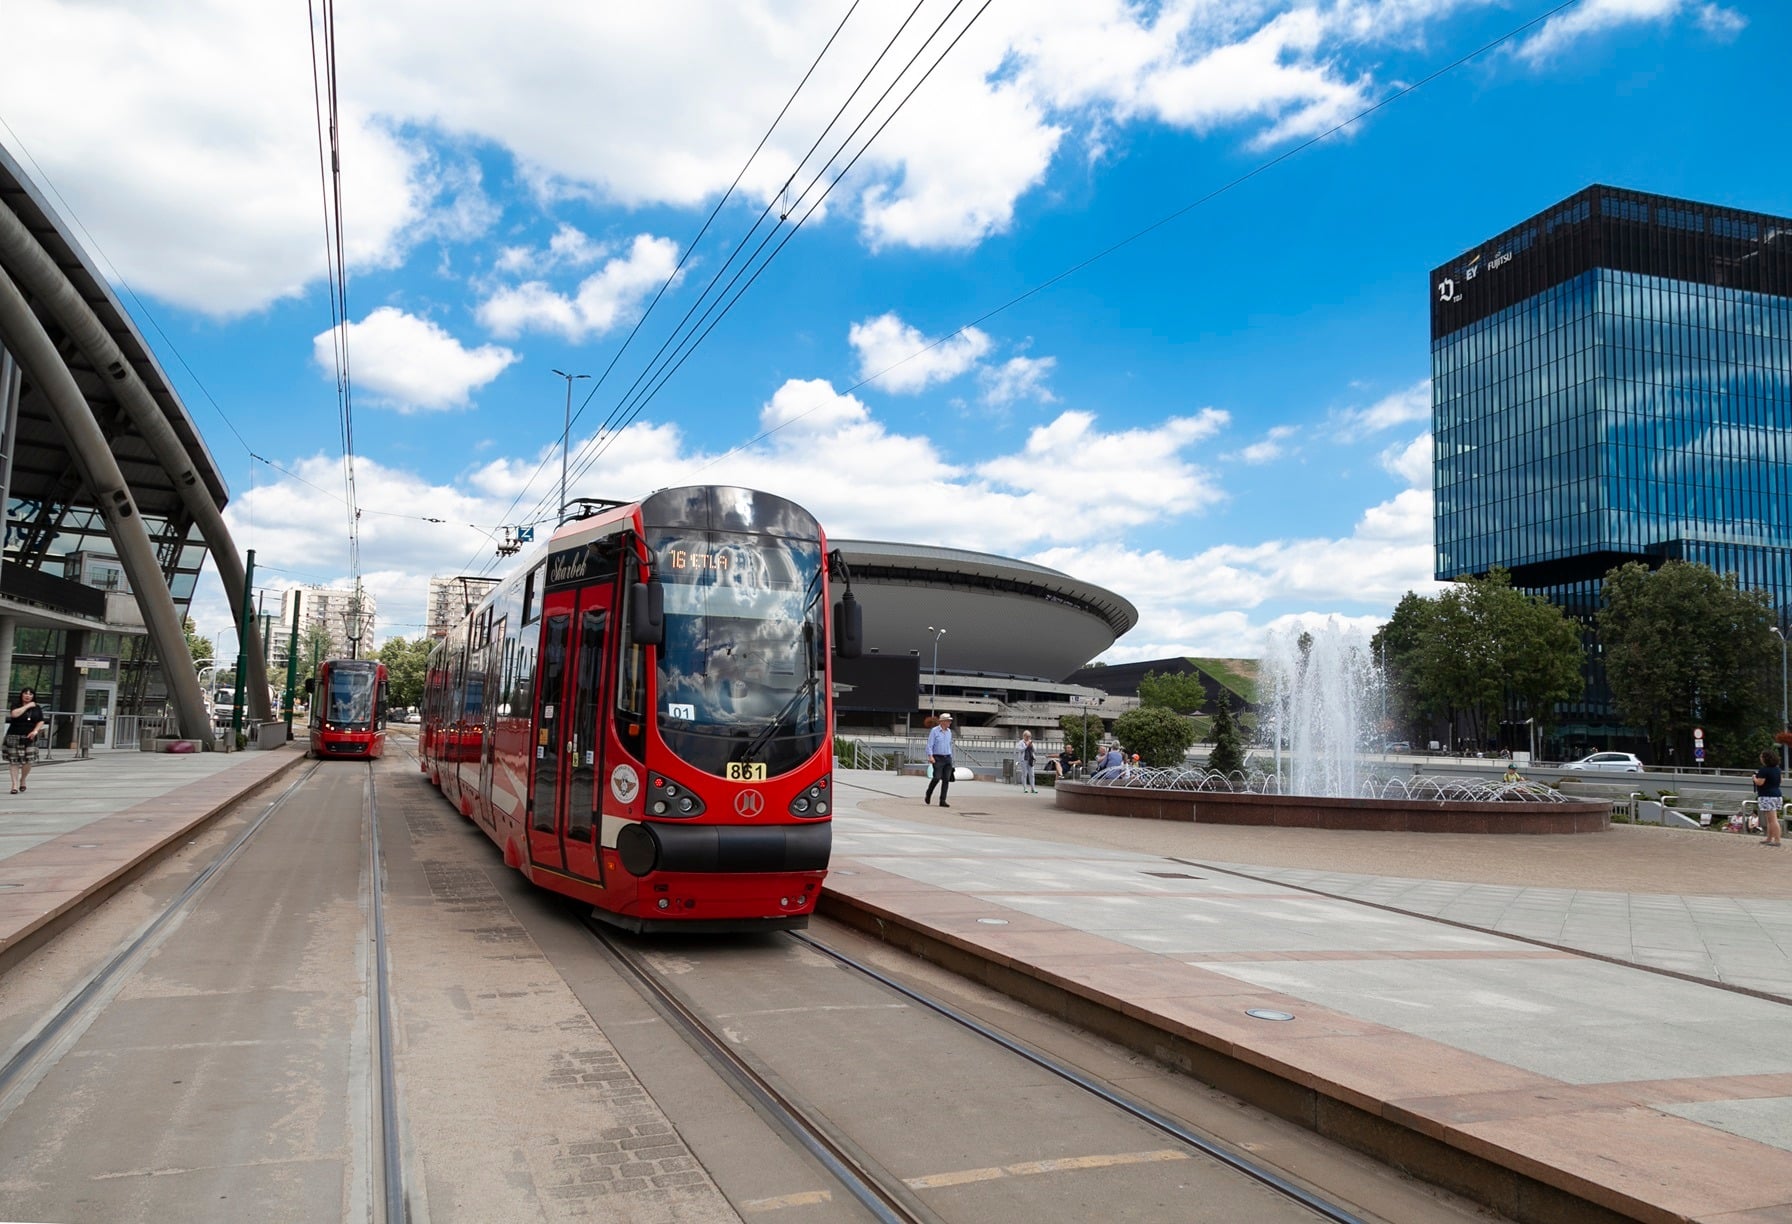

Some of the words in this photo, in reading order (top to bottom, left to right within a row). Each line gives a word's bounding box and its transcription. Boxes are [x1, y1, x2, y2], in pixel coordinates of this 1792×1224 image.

[1487, 252, 1512, 271] FUJITSU
[1466, 265, 1478, 281] EY
[550, 550, 590, 583] Skarbek
[669, 549, 686, 569] 16
[673, 707, 689, 719] 01
[731, 764, 763, 780] 861
